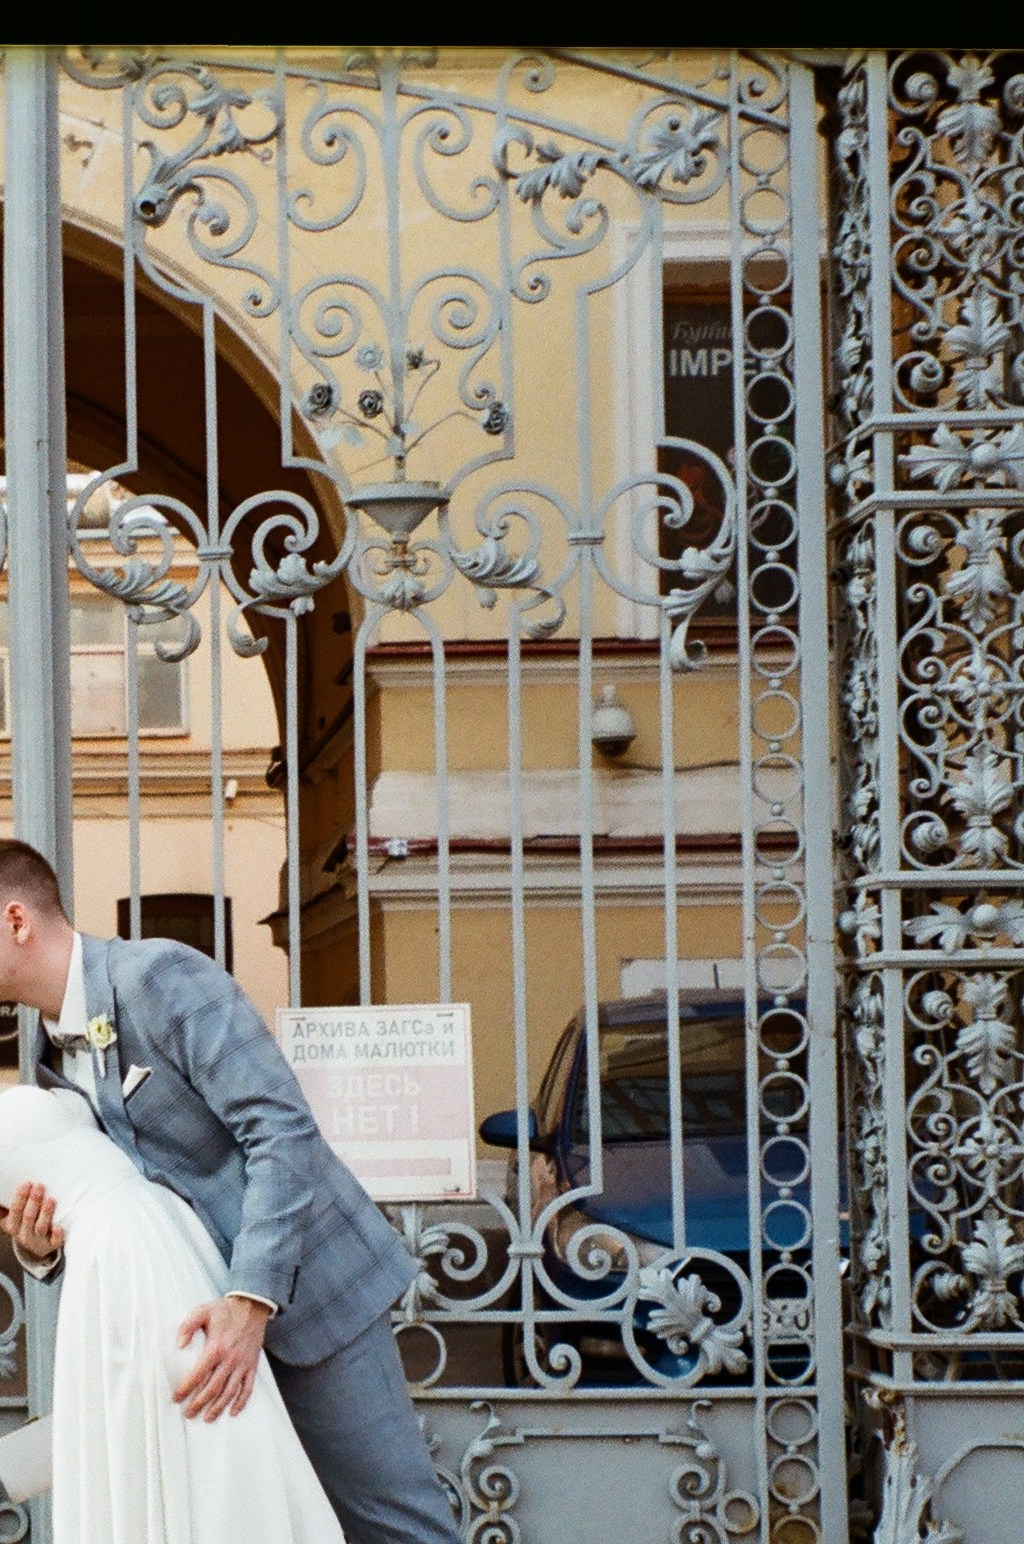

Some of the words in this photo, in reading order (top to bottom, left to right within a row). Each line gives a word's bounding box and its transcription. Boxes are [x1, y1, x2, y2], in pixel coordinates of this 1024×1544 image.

[293, 1022, 370, 1038] АРХИВА
[293, 1044, 347, 1062] ДОМА
[354, 1040, 454, 1059] МАЛЮТКИ
[327, 1073, 421, 1102] ЗДЕСЬ
